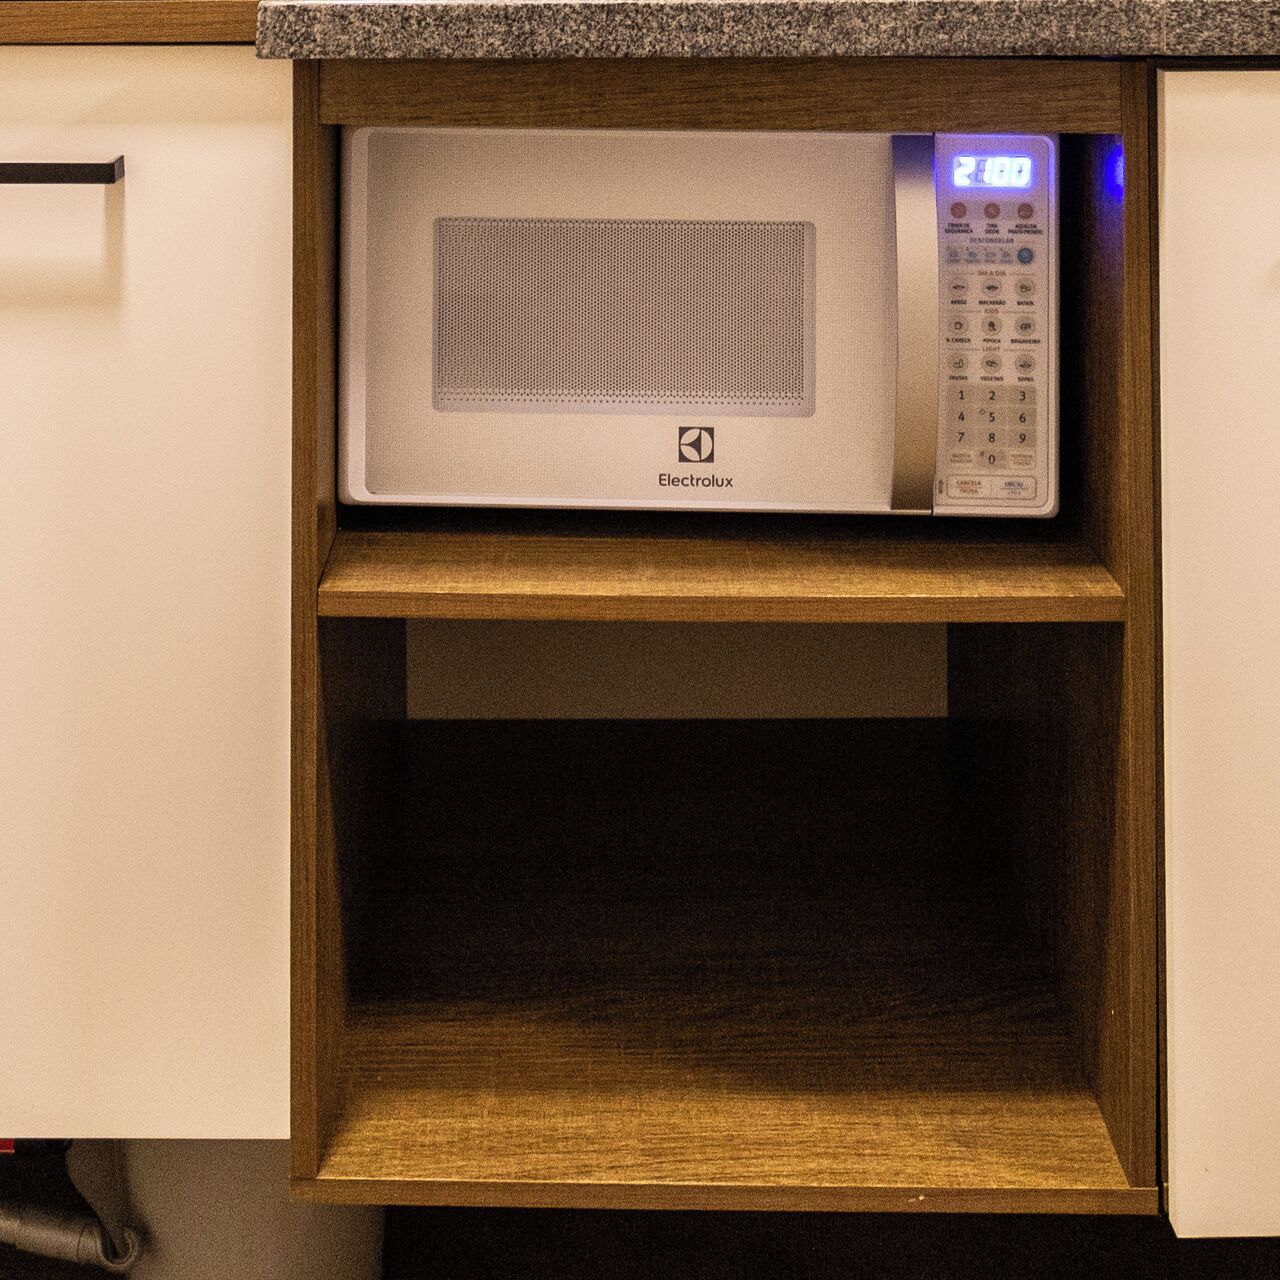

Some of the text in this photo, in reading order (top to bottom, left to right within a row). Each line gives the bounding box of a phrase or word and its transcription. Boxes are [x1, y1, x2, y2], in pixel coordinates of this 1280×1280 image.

[958, 390, 964, 400] 1
[989, 390, 996, 400] 2
[1020, 391, 1026, 401] 3
[958, 412, 965, 422] 4
[989, 412, 996, 422] 5
[1019, 413, 1026, 423] 6
[958, 432, 965, 442] 7
[988, 432, 996, 443] 8
[1020, 433, 1026, 444] 9
[988, 454, 996, 464] 0
[658, 473, 734, 488] Electrolux
